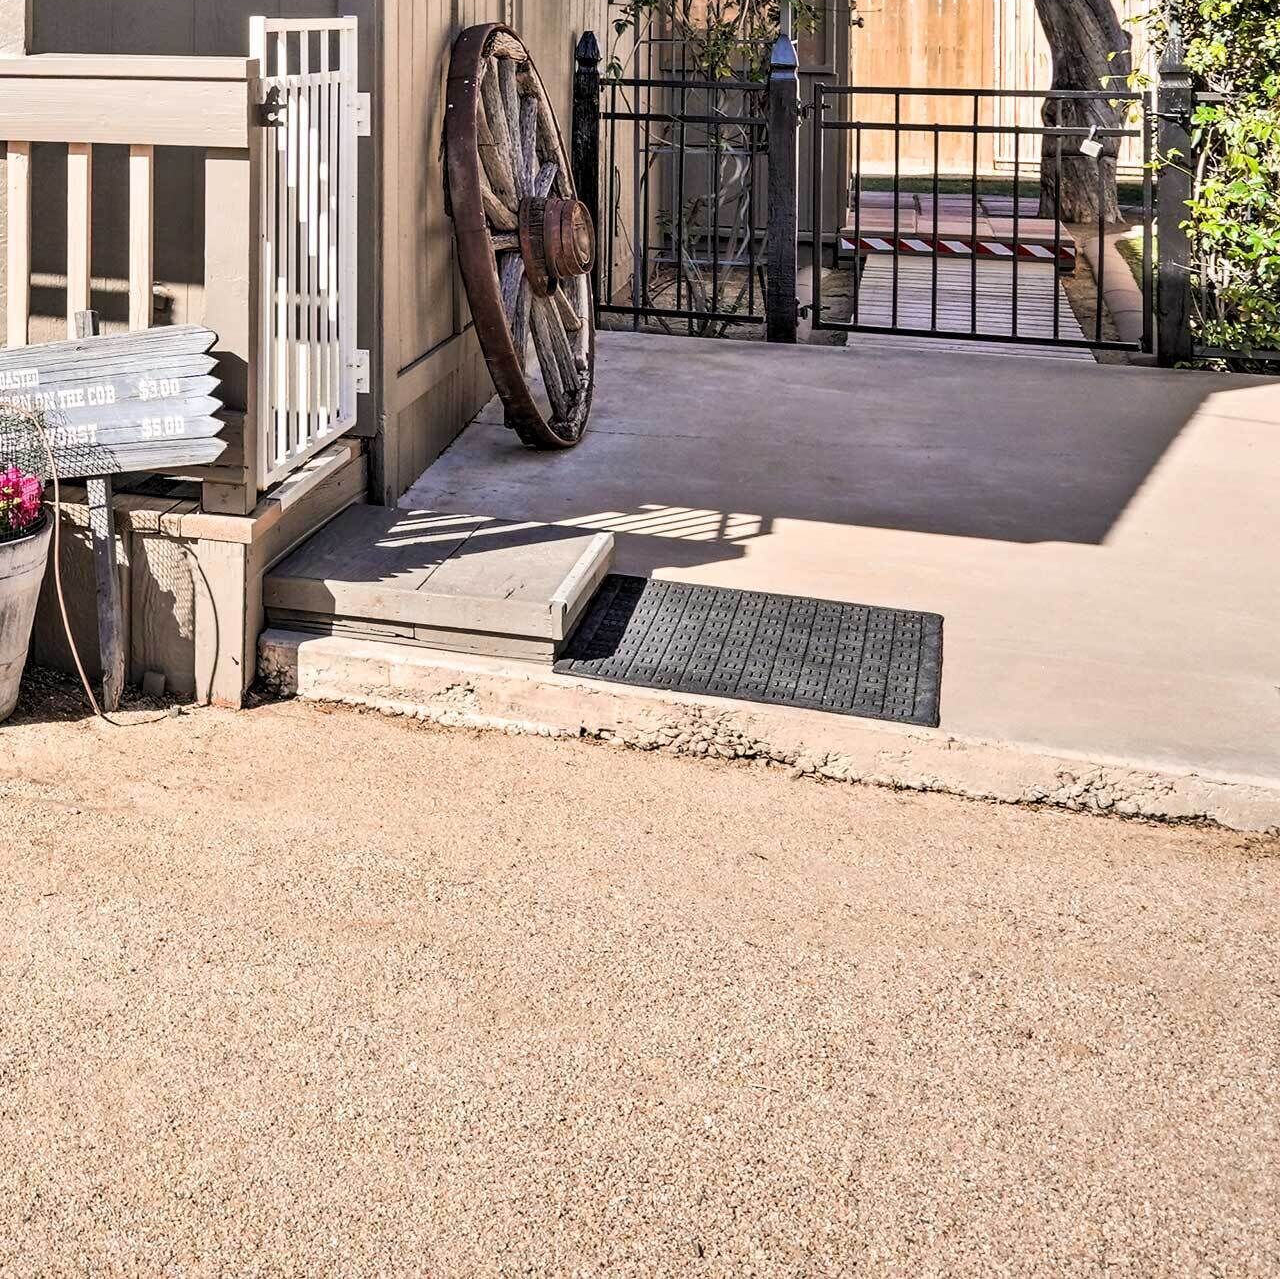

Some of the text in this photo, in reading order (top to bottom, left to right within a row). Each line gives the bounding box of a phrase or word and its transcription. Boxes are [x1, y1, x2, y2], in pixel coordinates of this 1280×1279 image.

[35, 391, 57, 411] ON
[57, 388, 85, 409] THE
[87, 385, 115, 405] COB
[139, 377, 180, 402] $3.00
[142, 415, 185, 439] $5.00
